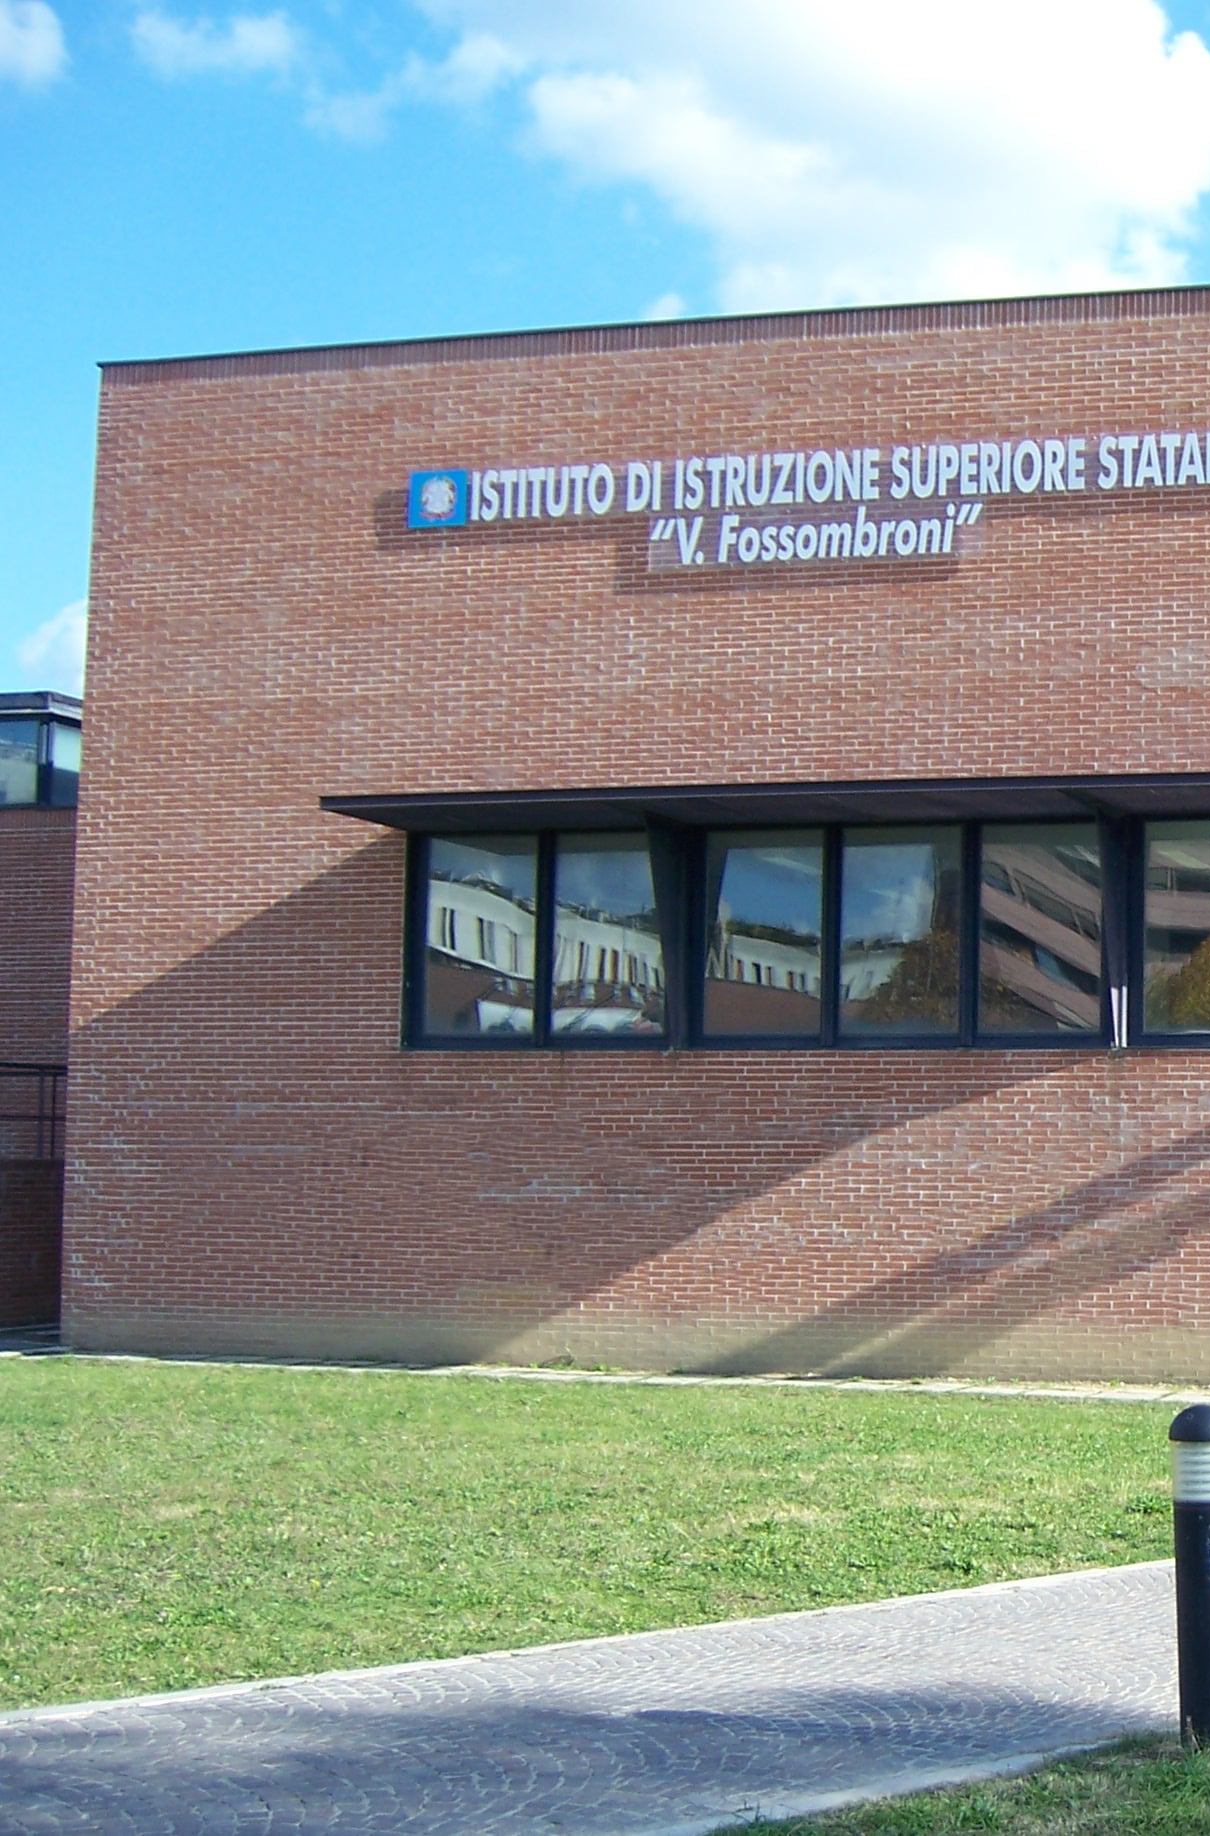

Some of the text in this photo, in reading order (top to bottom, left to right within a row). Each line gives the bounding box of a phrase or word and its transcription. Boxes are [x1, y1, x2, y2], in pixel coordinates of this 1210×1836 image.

[470, 463, 615, 522] ISTITUTO
[626, 460, 662, 514] DI
[674, 447, 881, 511] ISTRUZIONE
[889, 436, 1087, 499] SUPERIORE
